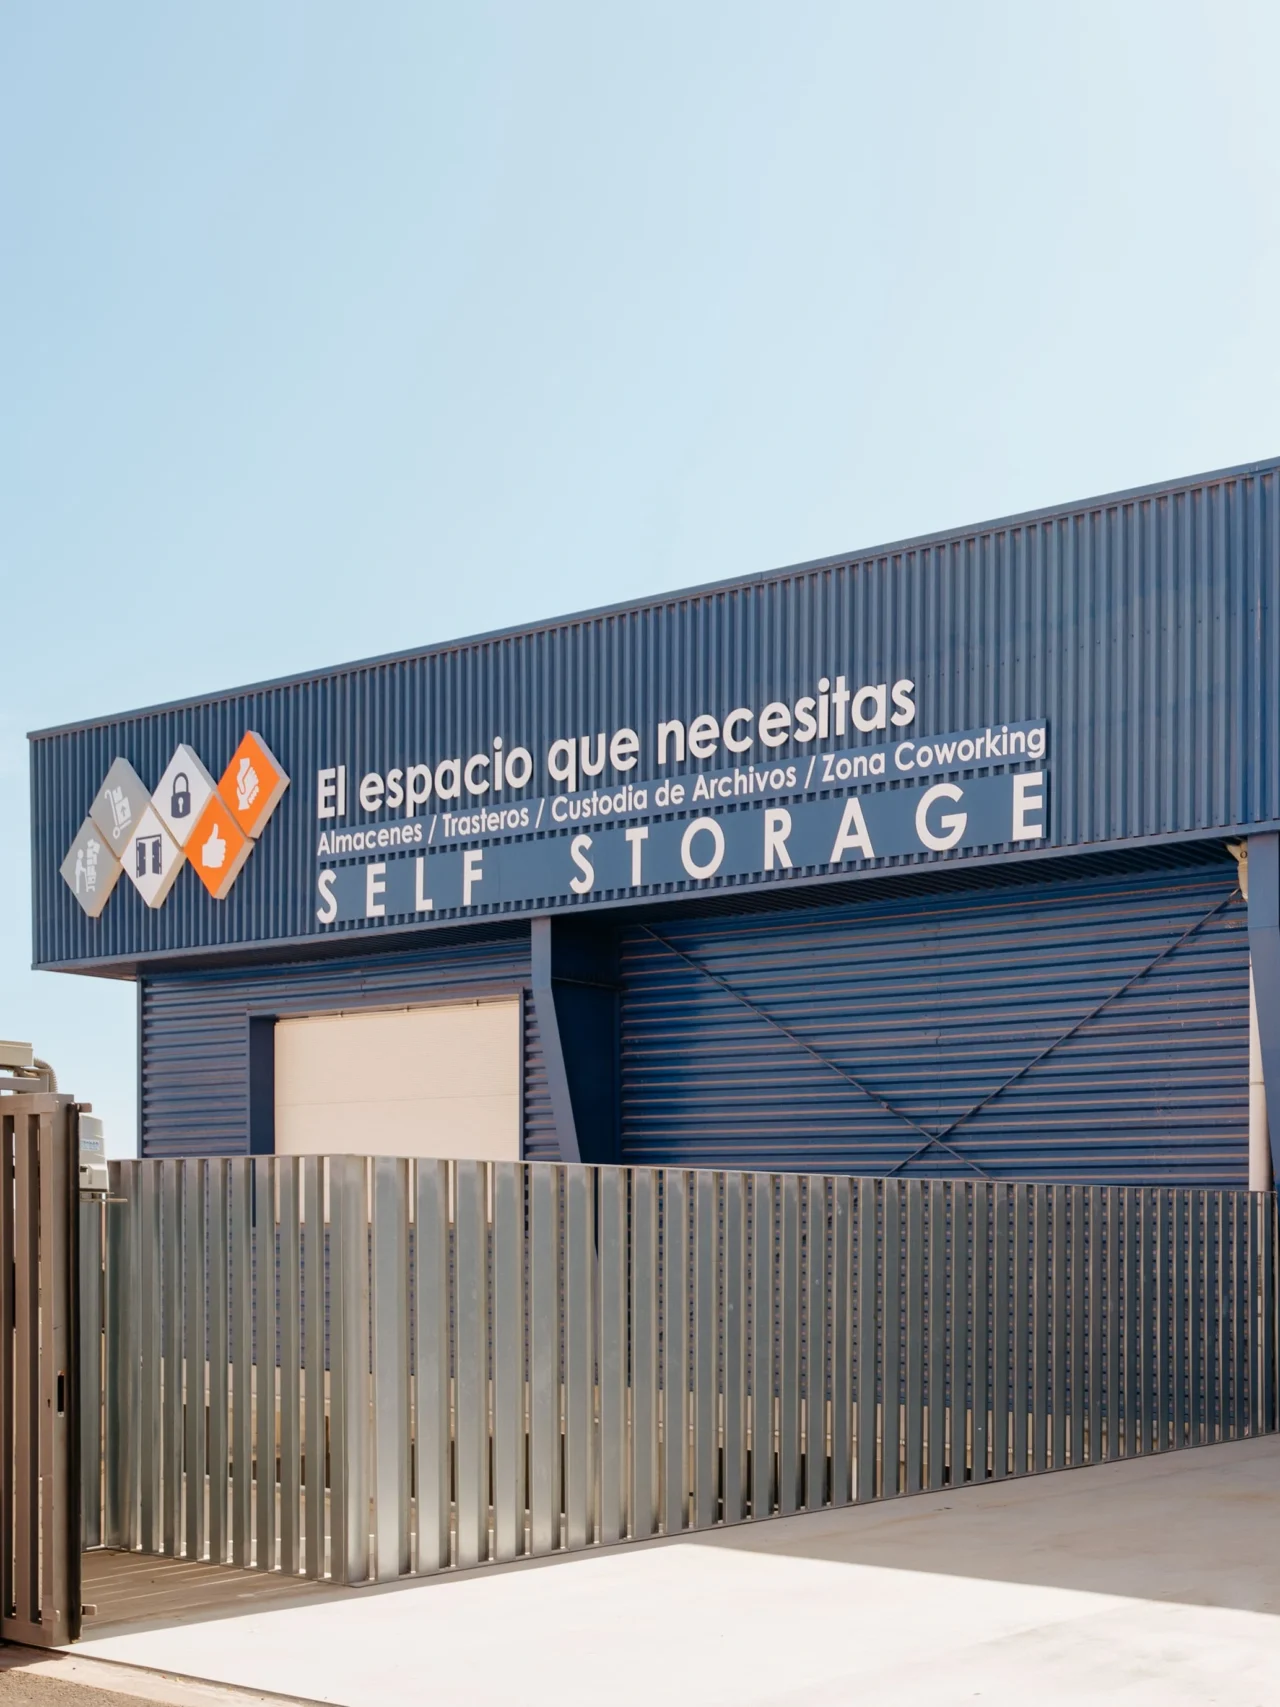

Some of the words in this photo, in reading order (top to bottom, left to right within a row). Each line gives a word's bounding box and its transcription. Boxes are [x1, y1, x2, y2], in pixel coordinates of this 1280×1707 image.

[316, 764, 347, 819] El
[358, 735, 534, 820] espacio
[546, 727, 640, 793] que
[656, 674, 917, 765] necesitas
[316, 820, 423, 856] Almacenes
[442, 806, 530, 838] Trasteros
[551, 784, 648, 823] Custodia
[655, 779, 686, 807] de
[691, 765, 797, 802] Archivos
[821, 750, 886, 784] Zona
[894, 724, 1047, 772] Coworking
[316, 848, 484, 924] SELF
[568, 770, 1045, 895] STORAGE
